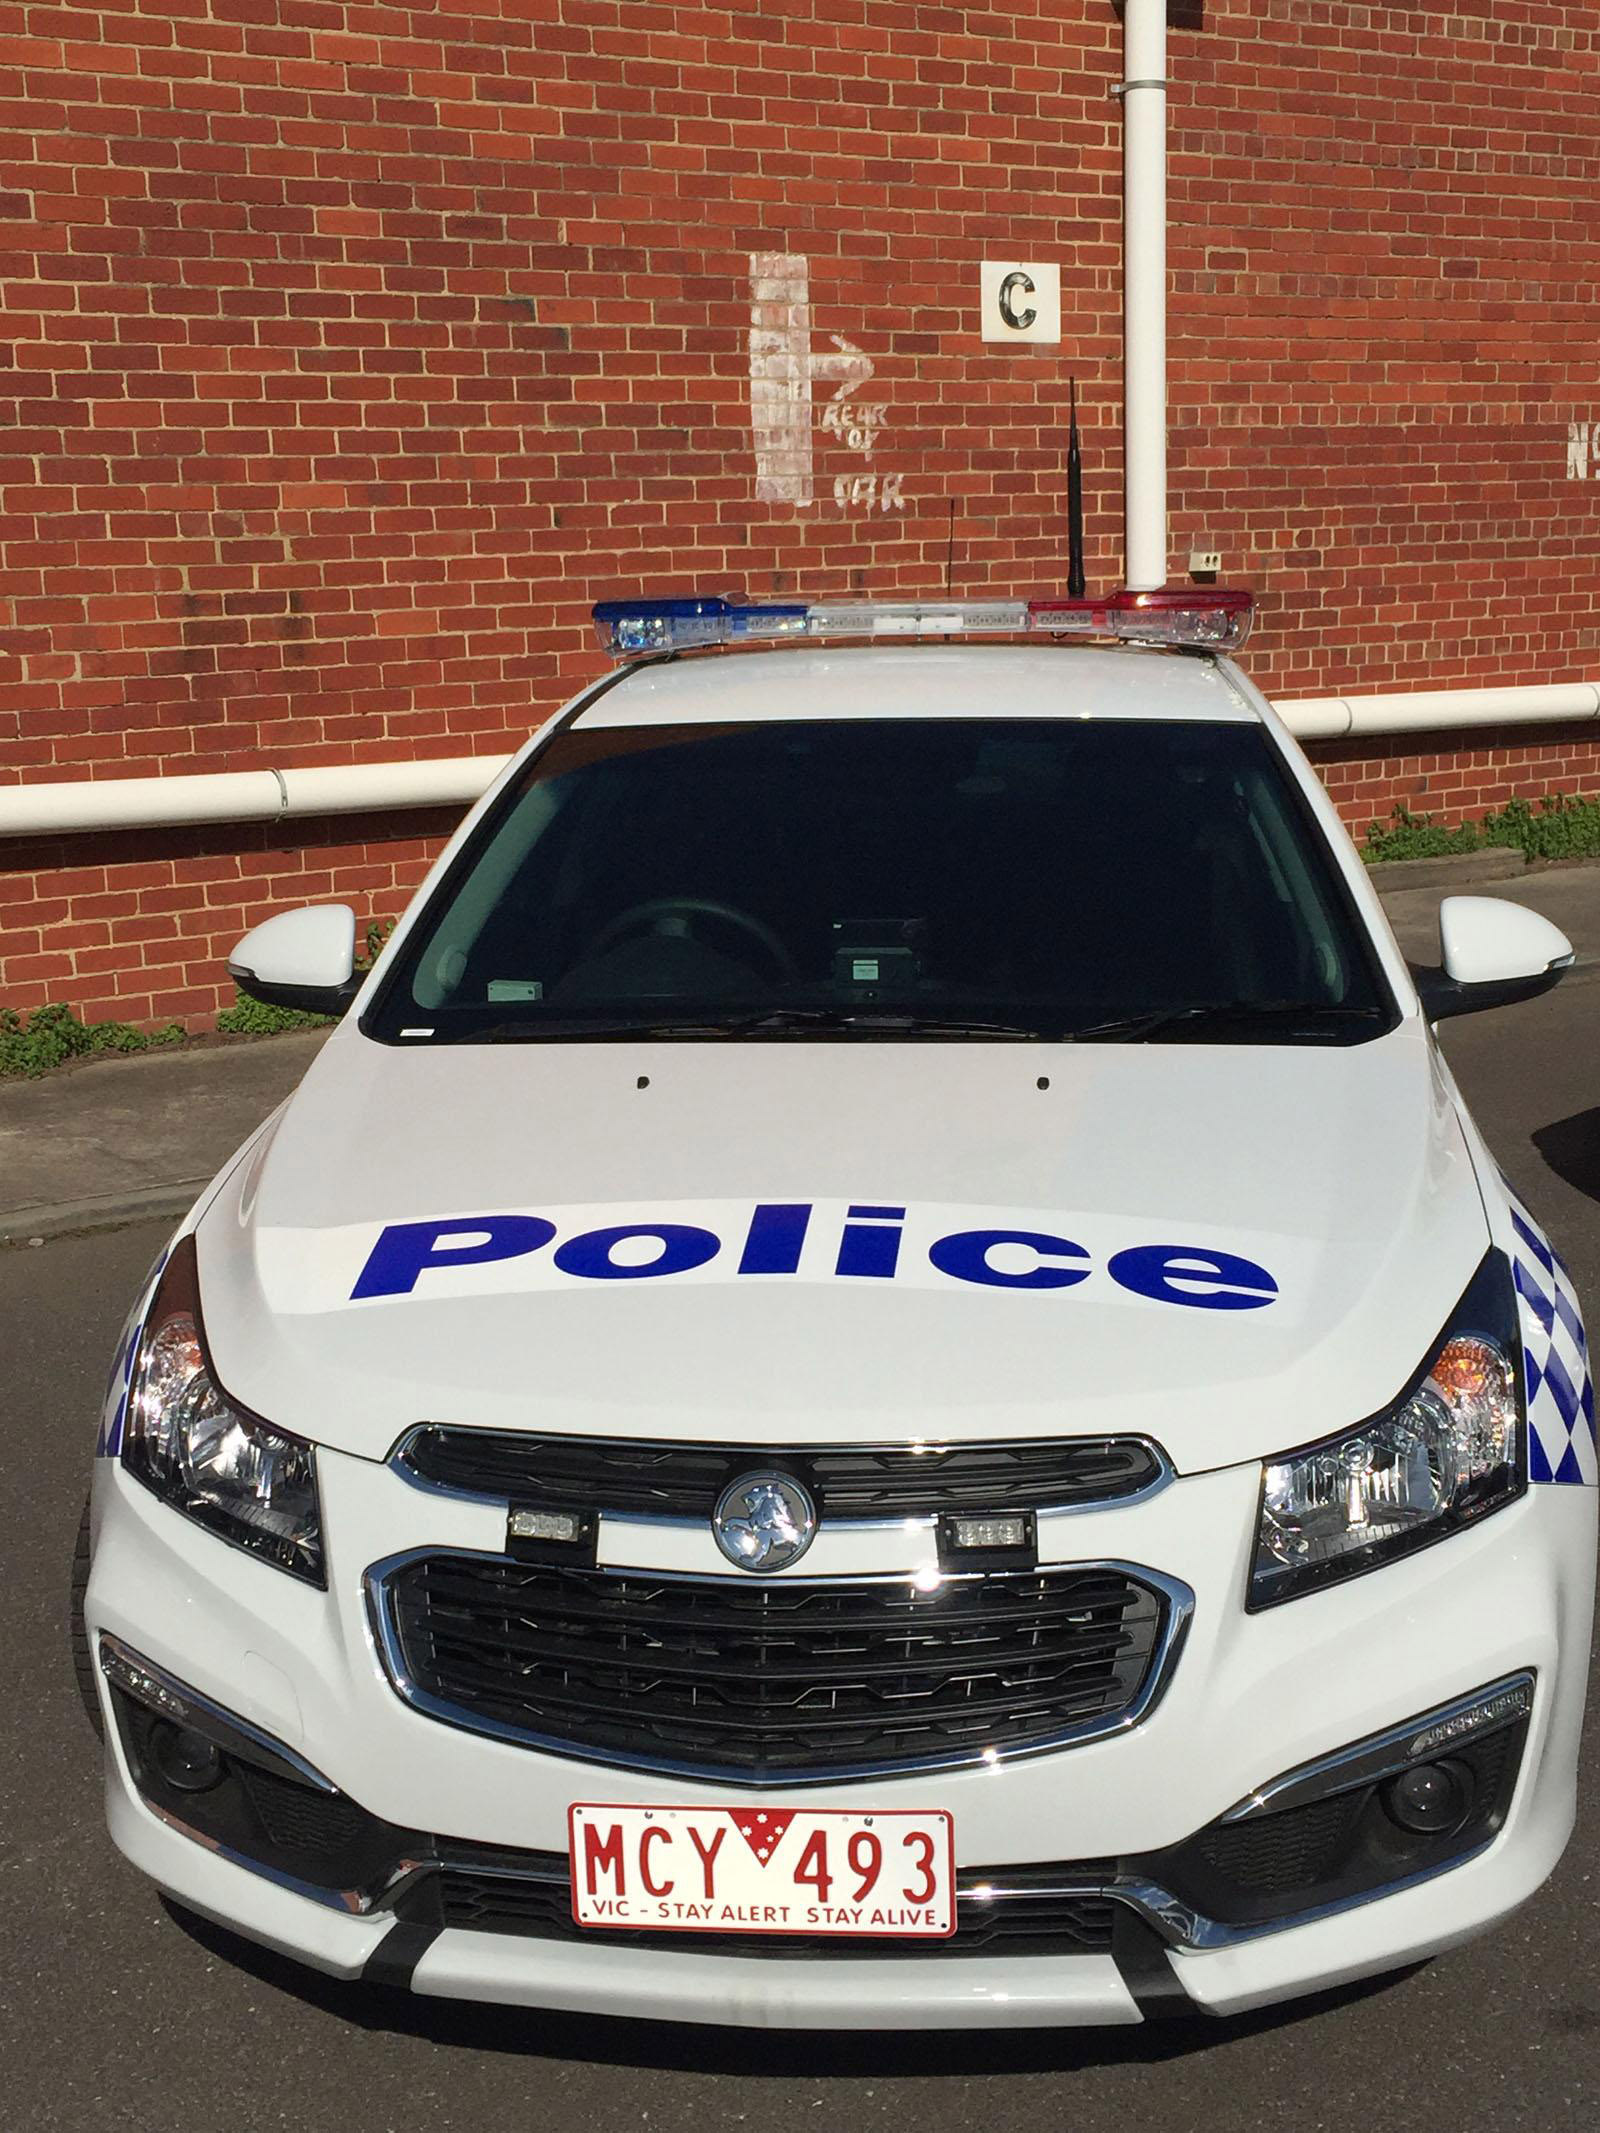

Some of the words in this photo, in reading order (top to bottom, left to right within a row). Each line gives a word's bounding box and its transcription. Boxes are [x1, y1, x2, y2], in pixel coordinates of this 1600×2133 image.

[999, 271, 1037, 330] C
[349, 1203, 1280, 1310] Police
[583, 1823, 726, 1899] MCY
[793, 1830, 936, 1904] 493
[592, 1899, 629, 1917] VIC
[658, 1902, 714, 1920] STAY
[720, 1903, 790, 1922] ALERT
[807, 1908, 863, 1925] STAY
[870, 1909, 936, 1926] ALIVE
